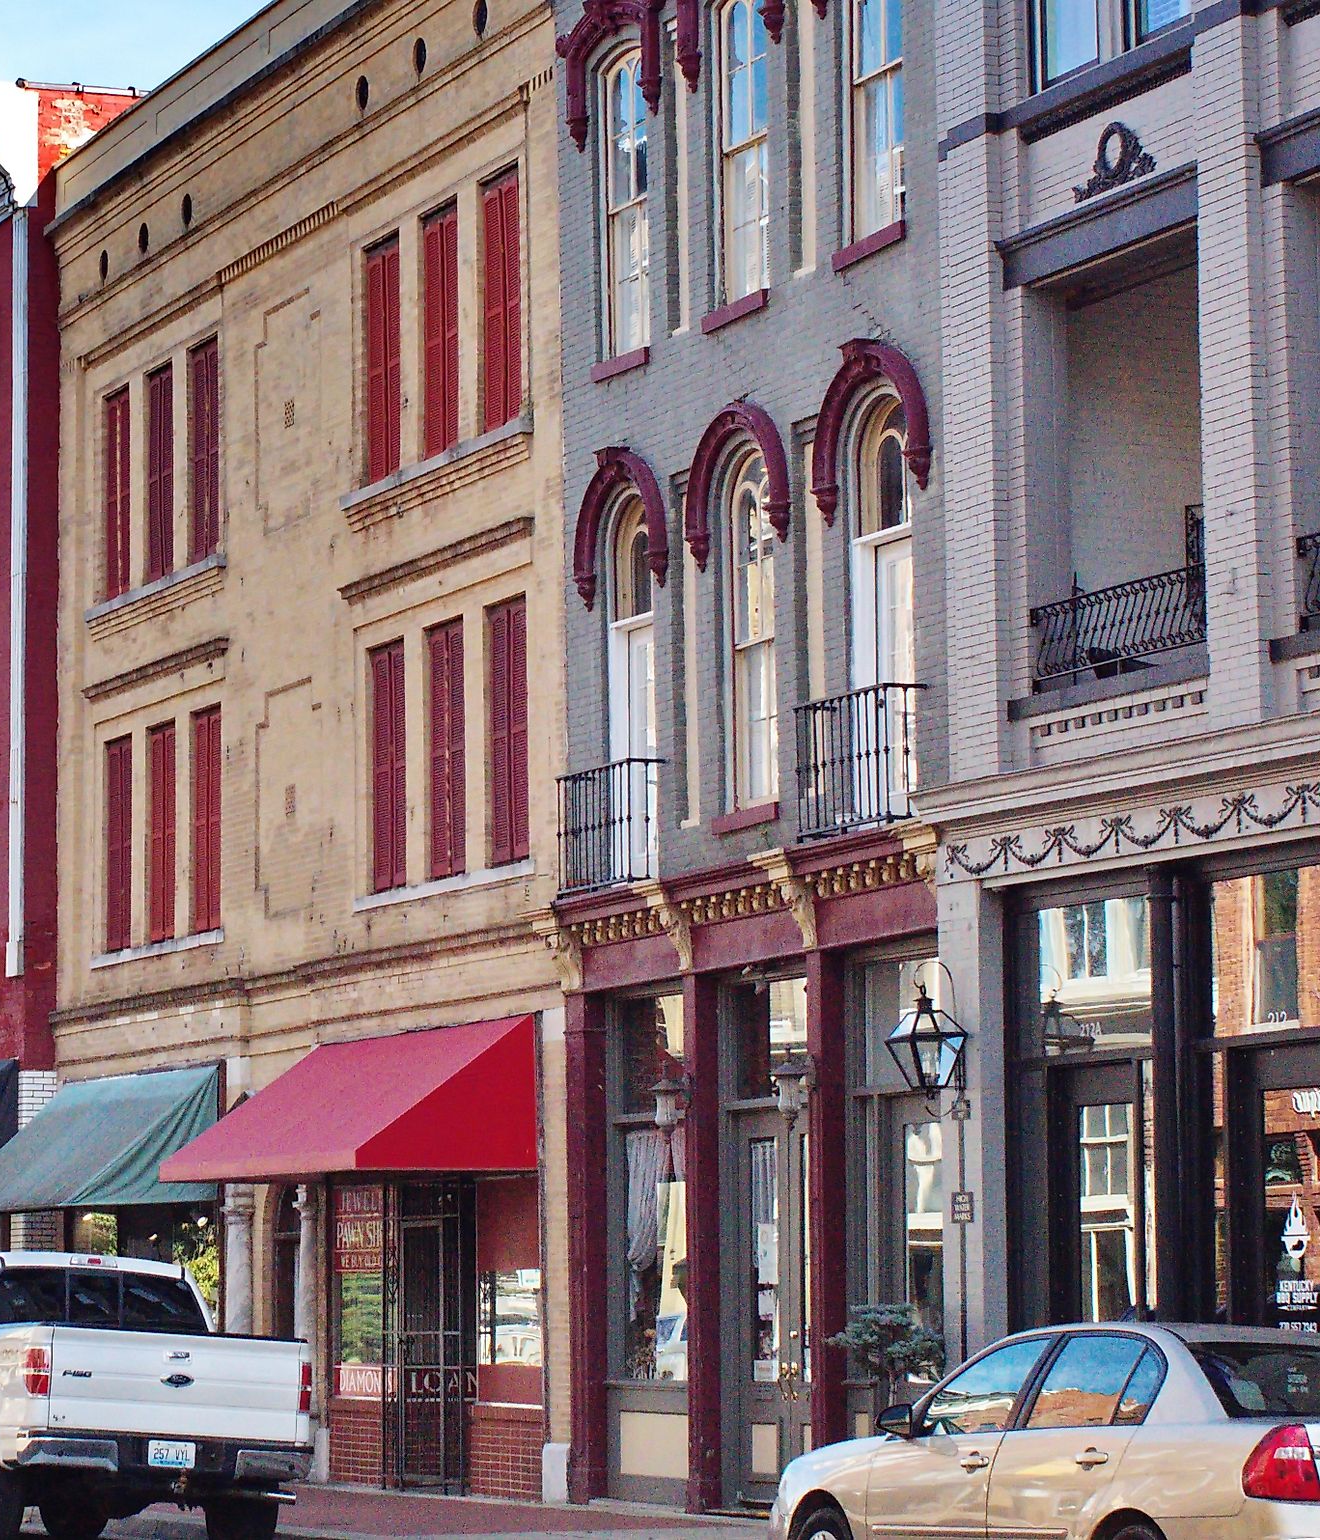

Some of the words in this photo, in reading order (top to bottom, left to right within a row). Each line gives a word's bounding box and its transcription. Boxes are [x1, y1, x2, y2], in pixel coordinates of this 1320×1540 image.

[1279, 1280, 1314, 1291] KENTUCKY
[1276, 1292, 1290, 1304] BBQ
[1292, 1292, 1318, 1303] SUPPLY
[62, 1370, 92, 1378] F-150
[340, 1370, 393, 1393] DIAMONS
[153, 1448, 170, 1460] 257
[175, 1449, 191, 1461] VYL
